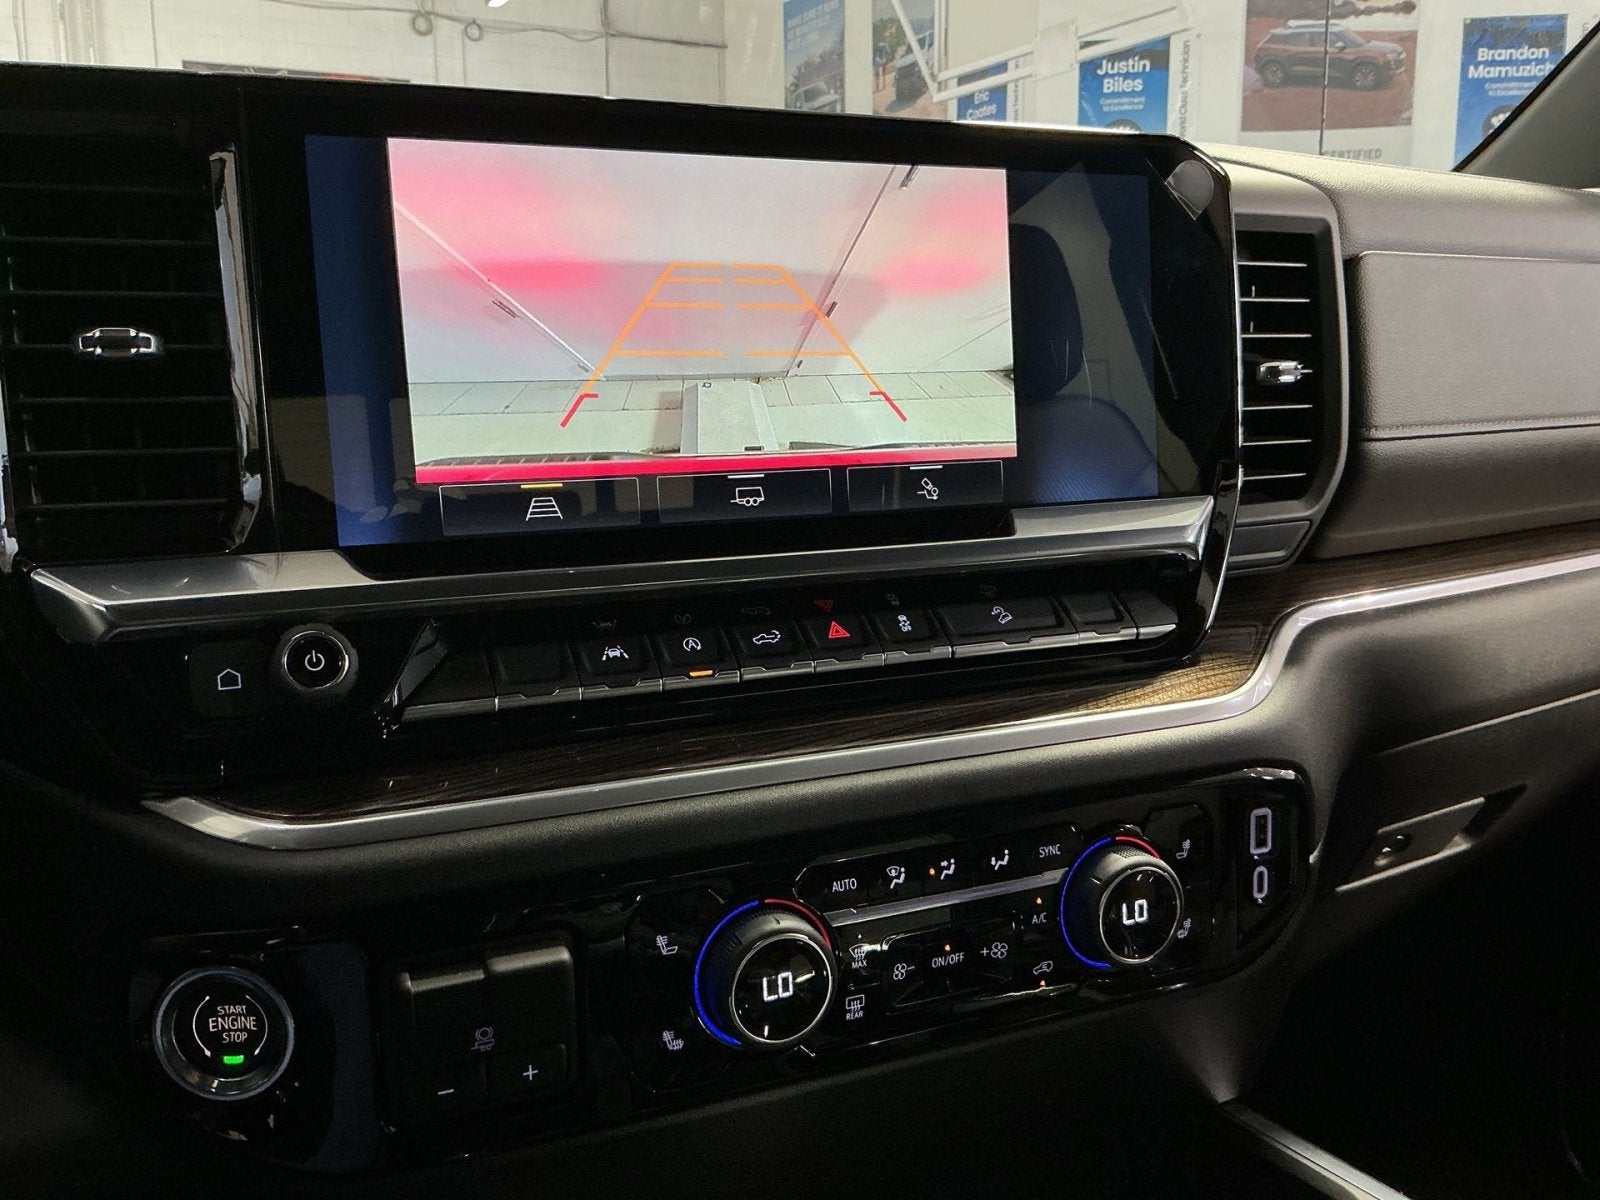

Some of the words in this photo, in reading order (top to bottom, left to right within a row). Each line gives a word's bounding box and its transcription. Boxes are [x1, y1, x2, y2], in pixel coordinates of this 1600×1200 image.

[1477, 45, 1549, 61] Brandon
[1097, 55, 1151, 75] Justin
[1103, 76, 1143, 93] Biles
[1039, 844, 1061, 858] SYNC
[832, 878, 857, 892] AUTO
[1031, 912, 1047, 925] A/C
[1122, 899, 1149, 926] LO
[851, 959, 867, 969] MAX
[931, 952, 965, 968] ON/OFF
[762, 971, 793, 1003] LO
[216, 1005, 247, 1015] START
[846, 1010, 864, 1020] REAR
[208, 1015, 258, 1032] ENGINE
[222, 1031, 248, 1043] STOP
